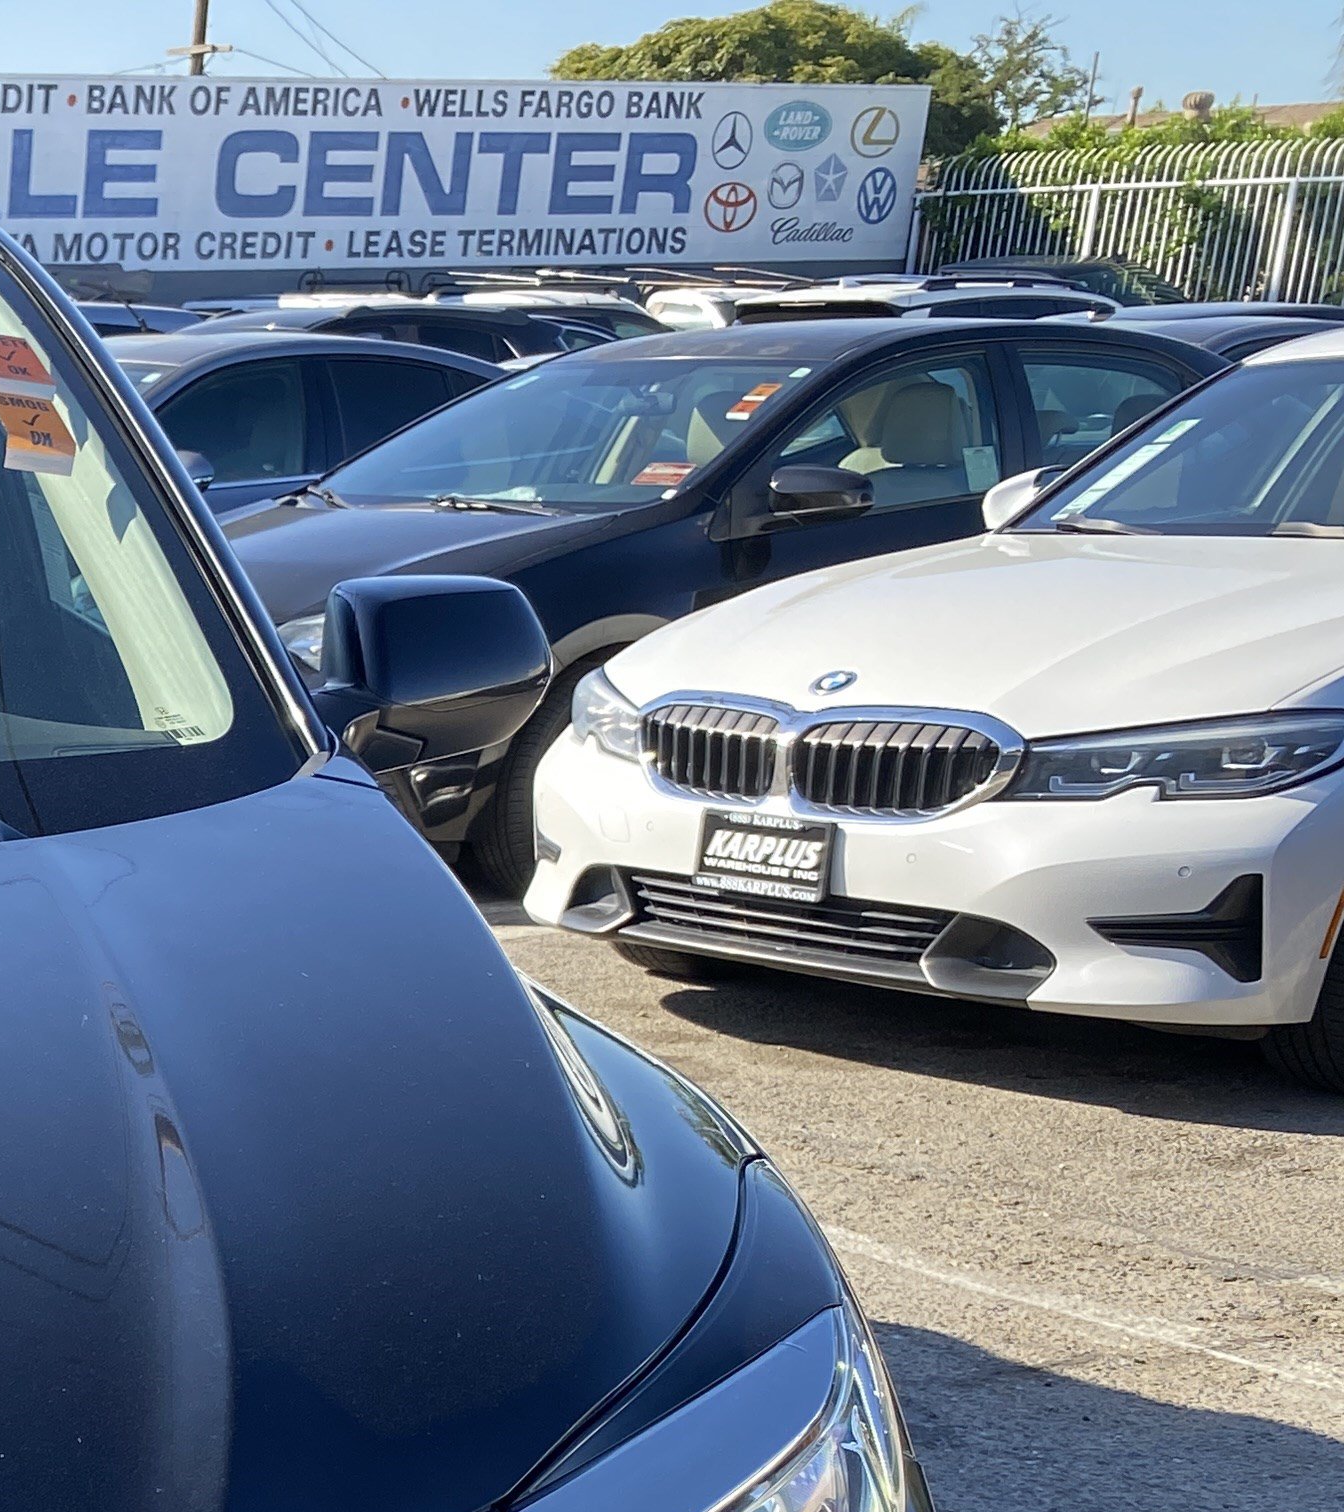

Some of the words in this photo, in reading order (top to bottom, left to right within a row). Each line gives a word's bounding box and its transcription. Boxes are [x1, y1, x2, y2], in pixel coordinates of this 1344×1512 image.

[85, 84, 180, 117] BANK
[190, 85, 230, 117] OF
[237, 86, 384, 118] AMERICA
[413, 88, 508, 119] WELLS
[519, 90, 614, 120] FARGO
[625, 91, 706, 121] BANK
[214, 130, 697, 216] CENTER
[53, 231, 181, 263] MOTOR
[194, 231, 316, 261] CREDIT
[347, 229, 446, 259] LEASE
[458, 226, 687, 258] TERMINATIONS
[770, 217, 854, 245] Cadillac
[8, 365, 32, 377] OK
[705, 829, 825, 870] KARPLUS
[703, 856, 790, 878] WAREHOUSE
[793, 869, 819, 882] INC
